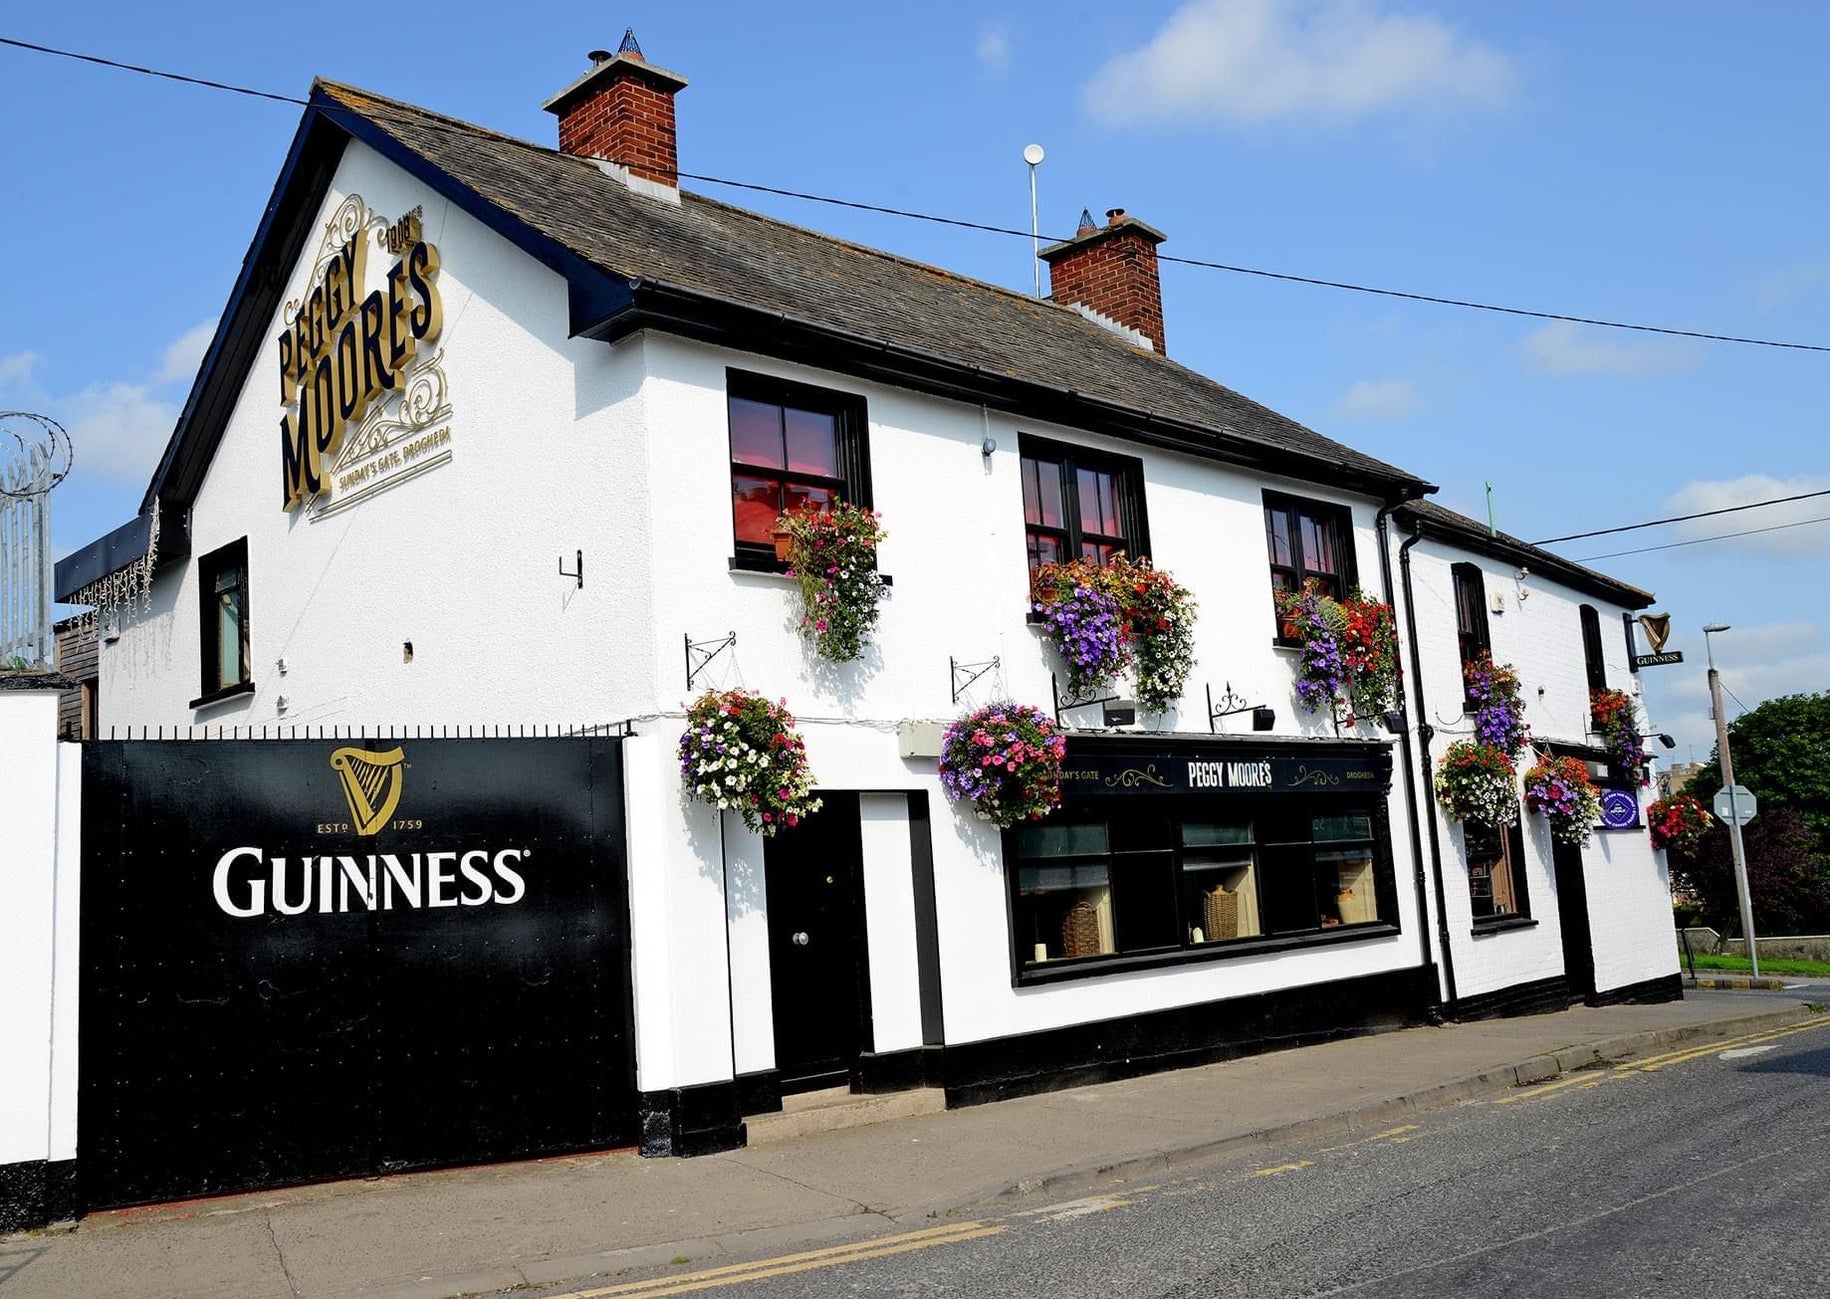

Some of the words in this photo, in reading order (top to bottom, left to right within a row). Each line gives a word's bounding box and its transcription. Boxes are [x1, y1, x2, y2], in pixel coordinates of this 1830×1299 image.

[278, 229, 365, 406] PEGGY
[280, 241, 437, 513] MOORES
[402, 426, 451, 460] DROGHEDA
[1636, 654, 1679, 665] GUINNESS
[1081, 770, 1099, 780] GATE
[1188, 761, 1223, 788] PEGGY
[1227, 760, 1272, 787] MOORE'S
[393, 820, 422, 830] 1759
[213, 846, 526, 918] GUINNESS
